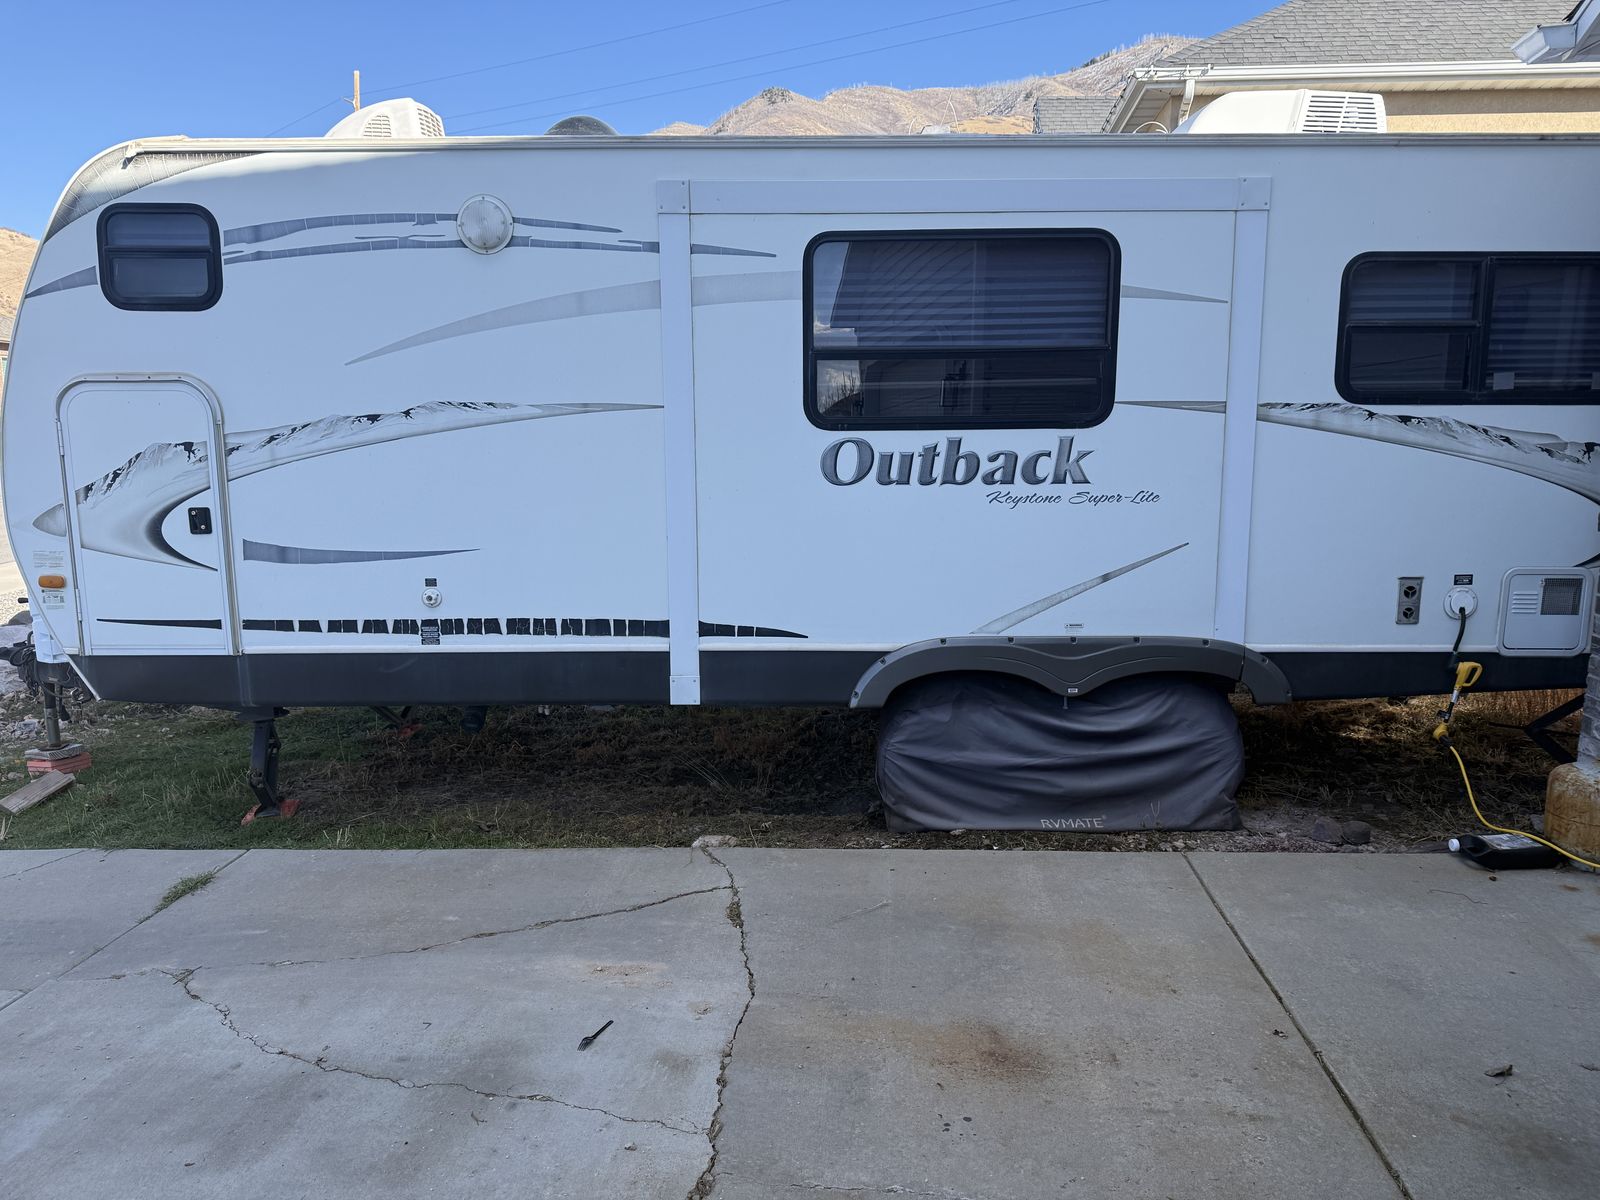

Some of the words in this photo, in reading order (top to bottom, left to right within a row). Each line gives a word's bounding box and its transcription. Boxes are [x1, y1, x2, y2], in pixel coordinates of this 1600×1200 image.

[820, 435, 1096, 487] Outback
[985, 490, 1062, 510] Keystone
[1068, 490, 1161, 507] Super-Lite
